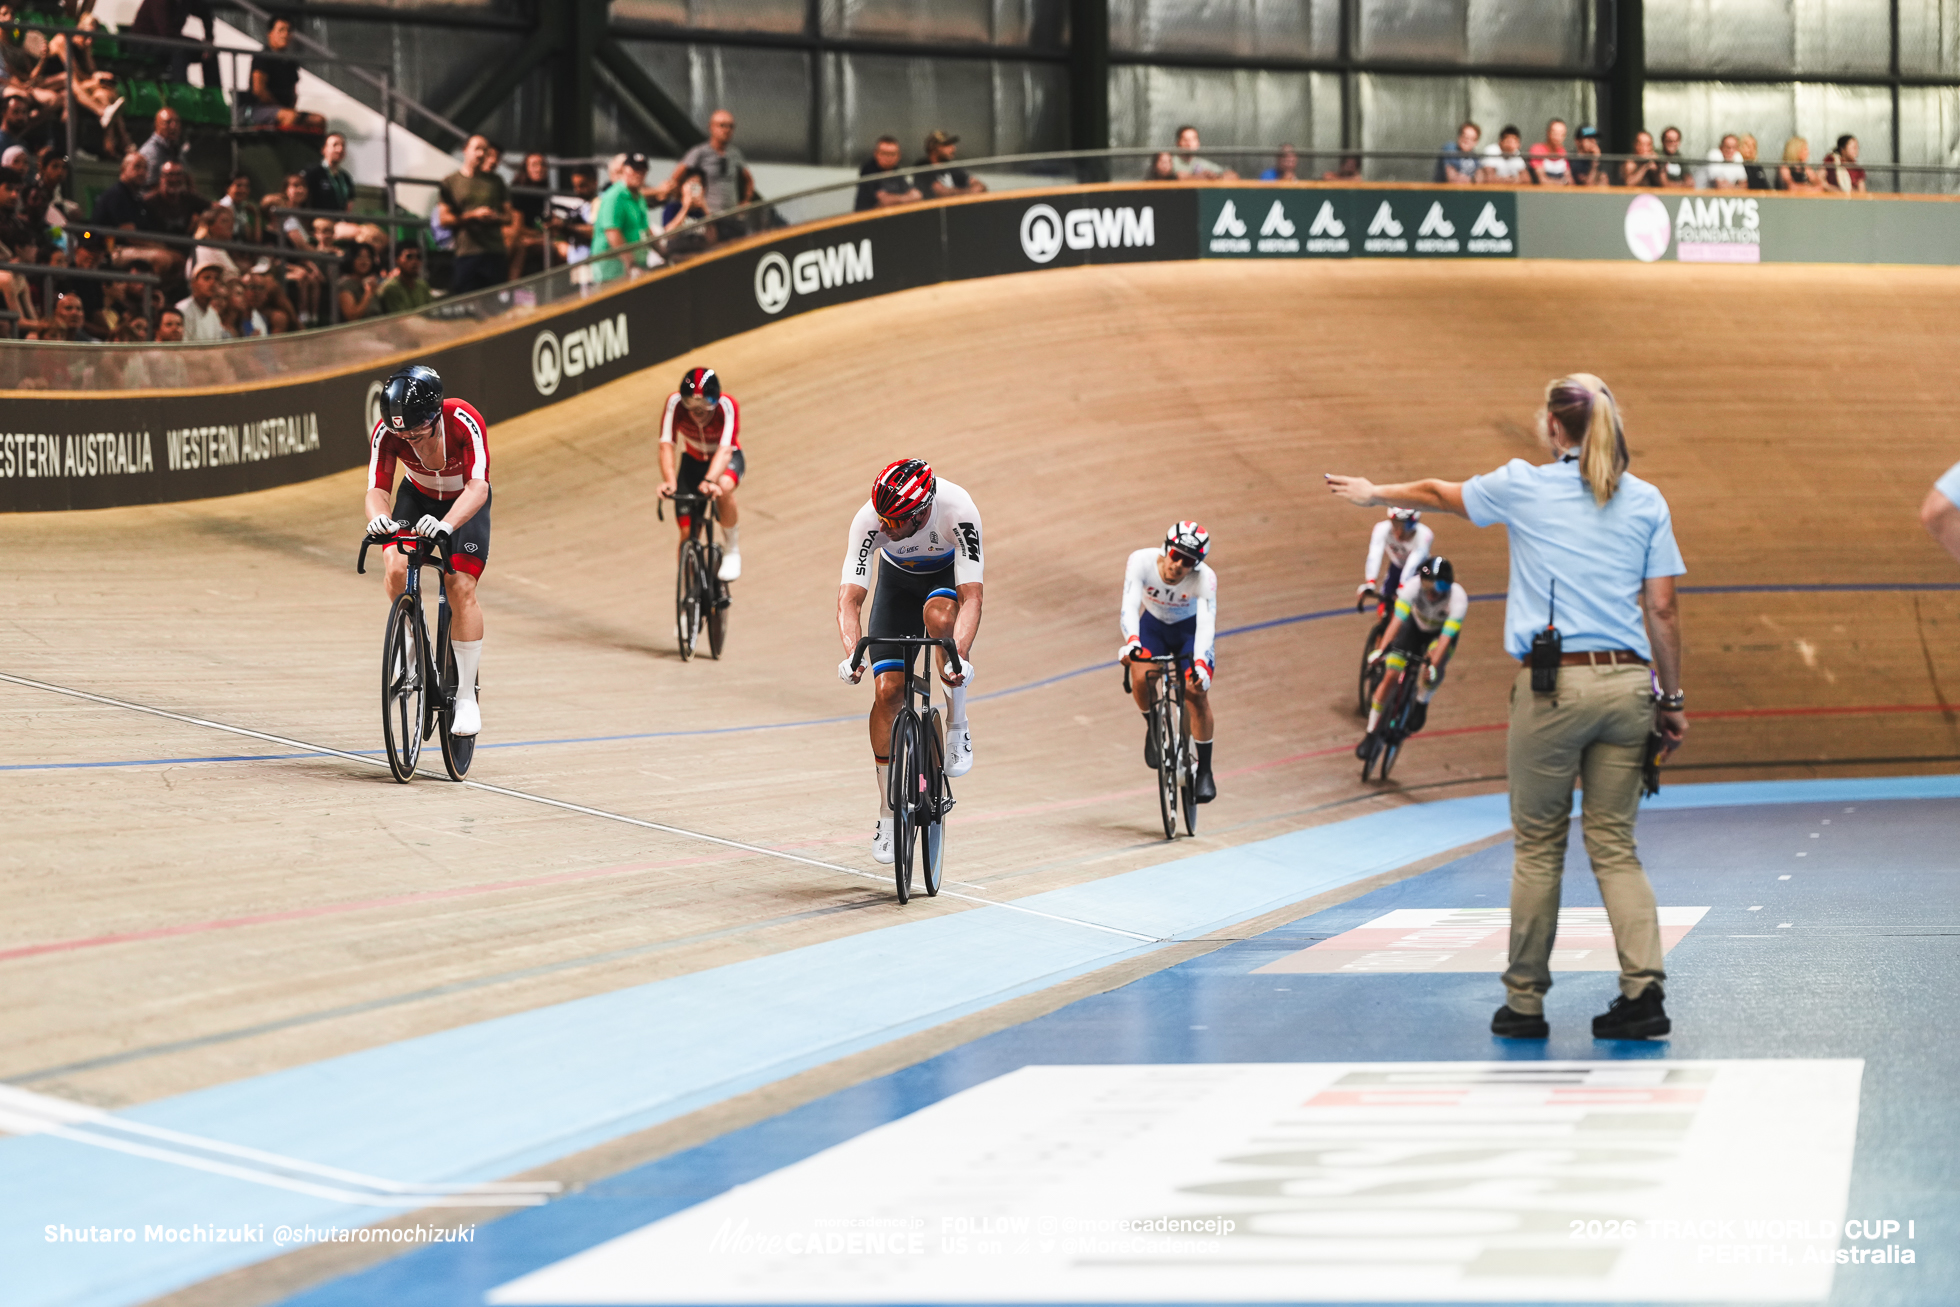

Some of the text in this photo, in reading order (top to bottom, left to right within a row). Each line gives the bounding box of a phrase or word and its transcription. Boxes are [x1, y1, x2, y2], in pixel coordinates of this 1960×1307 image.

[1064, 206, 1155, 250] GWM
[1676, 197, 1760, 229] AMY'S
[792, 238, 874, 295] GWM
[562, 312, 629, 377] GWM
[63, 431, 154, 478] AUSTRALIA
[167, 423, 239, 471] WESTERN
[242, 411, 320, 463] AUSTRALIA
